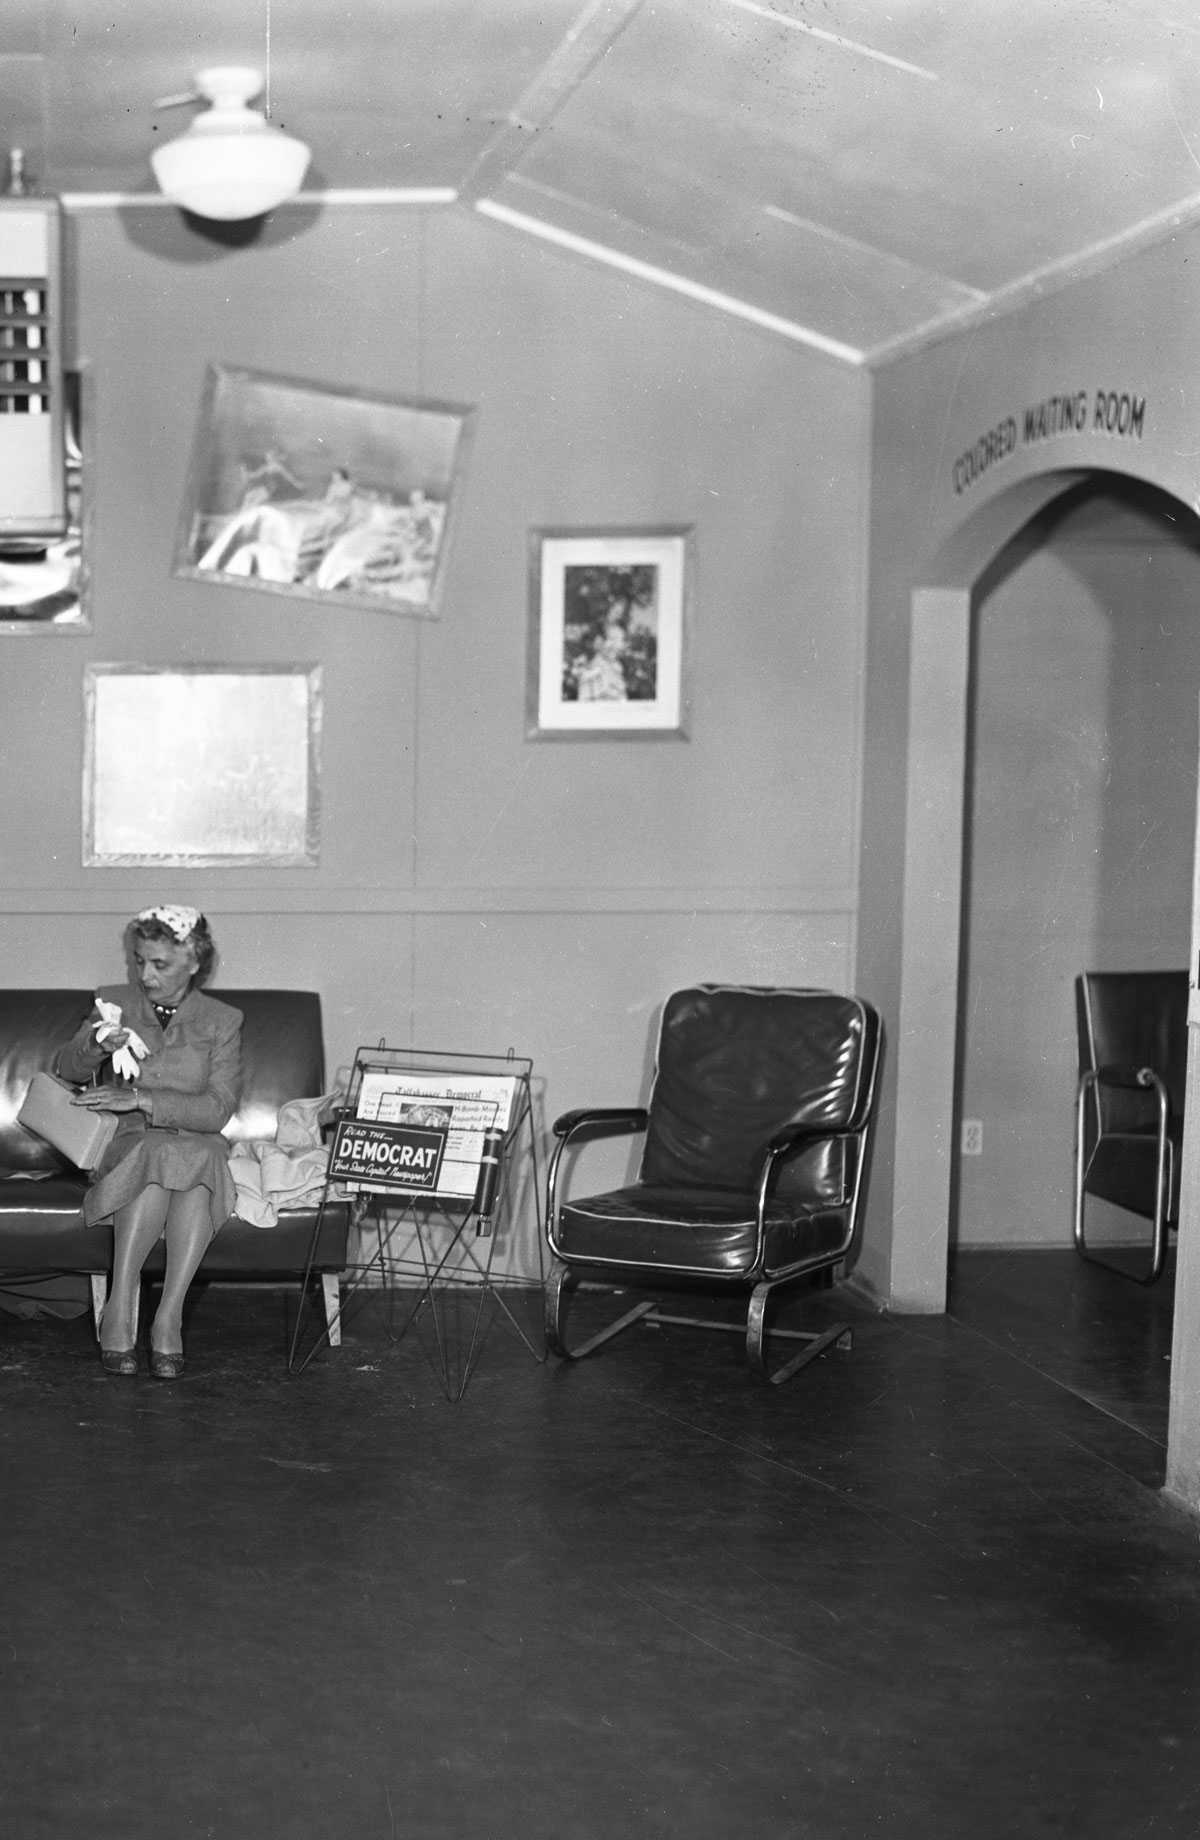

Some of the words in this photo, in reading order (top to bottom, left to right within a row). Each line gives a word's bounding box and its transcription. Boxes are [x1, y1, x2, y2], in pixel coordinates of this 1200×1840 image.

[952, 416, 1017, 495] COLORED
[1023, 390, 1087, 443] WAITING
[1093, 389, 1146, 439] ROOM
[343, 1126, 367, 1137] READ
[339, 1138, 437, 1169] DEMOCRAT
